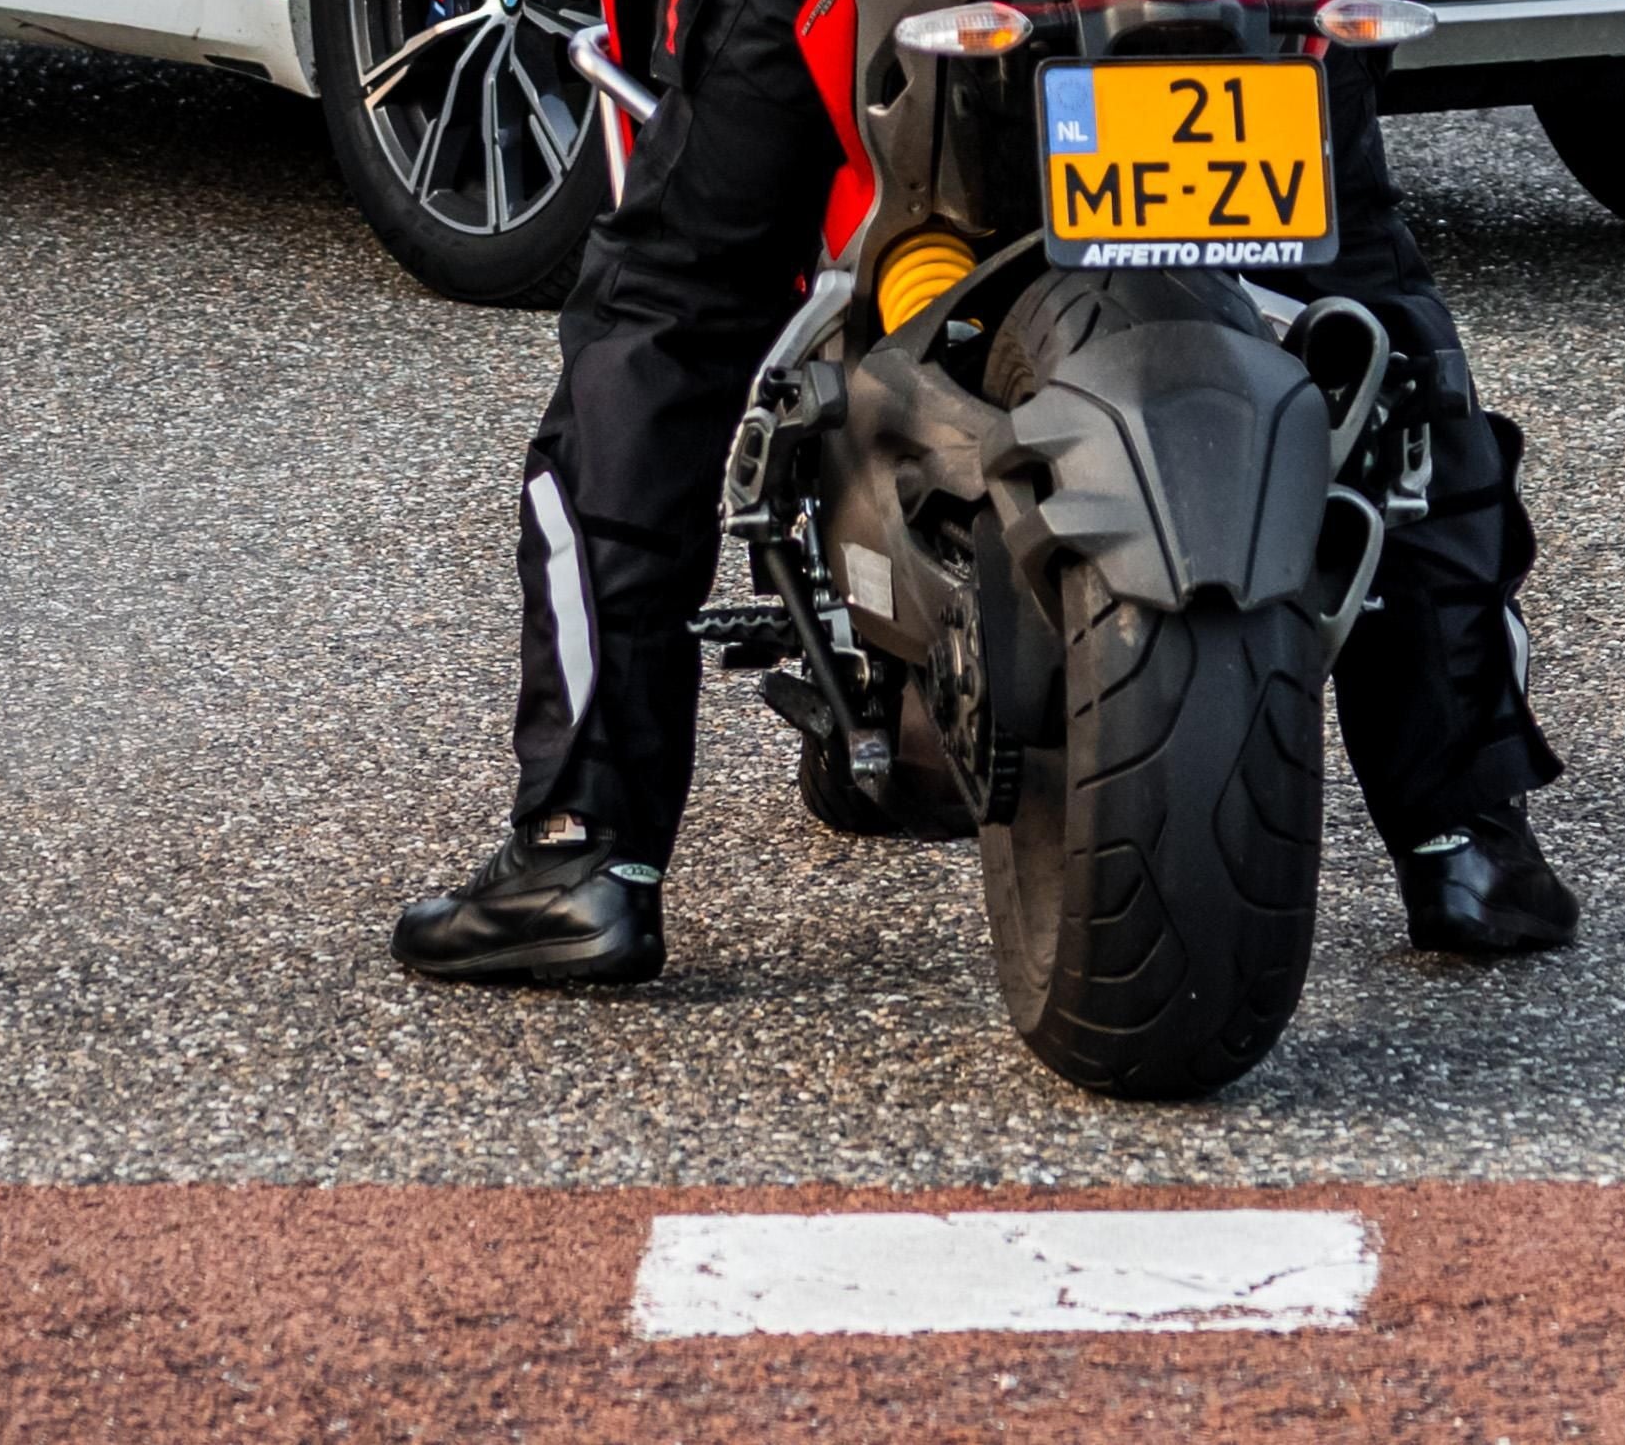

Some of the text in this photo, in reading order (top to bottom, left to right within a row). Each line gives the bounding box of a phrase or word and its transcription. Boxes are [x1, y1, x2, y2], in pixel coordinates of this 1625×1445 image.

[1057, 120, 1089, 142] NL
[1170, 77, 1246, 143] 21
[1064, 160, 1306, 227] MF-ZV
[1081, 241, 1304, 267] AFFETTO DUCATI
